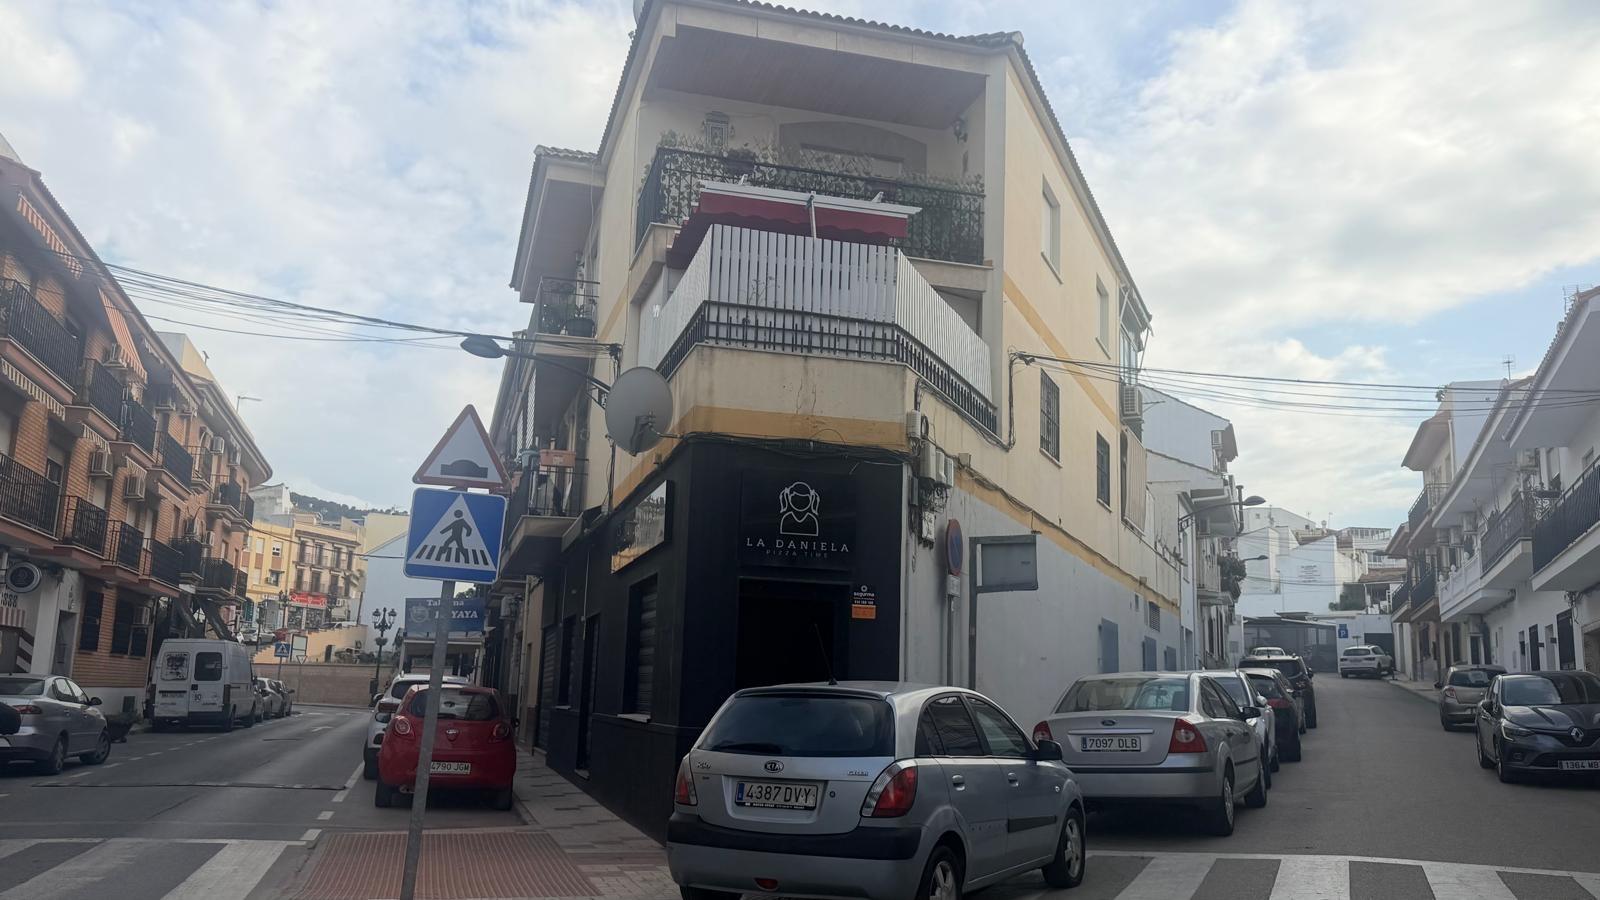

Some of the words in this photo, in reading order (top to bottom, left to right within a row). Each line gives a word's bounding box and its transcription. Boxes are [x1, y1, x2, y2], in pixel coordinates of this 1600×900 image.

[746, 537, 766, 548] LA
[775, 539, 849, 553] DANIELA
[451, 610, 479, 619] YAYA
[1088, 738, 1114, 749] 7097
[1118, 738, 1138, 749] DLB
[766, 761, 783, 771] KIA
[746, 784, 782, 801] 4387
[783, 785, 811, 804] DVY
